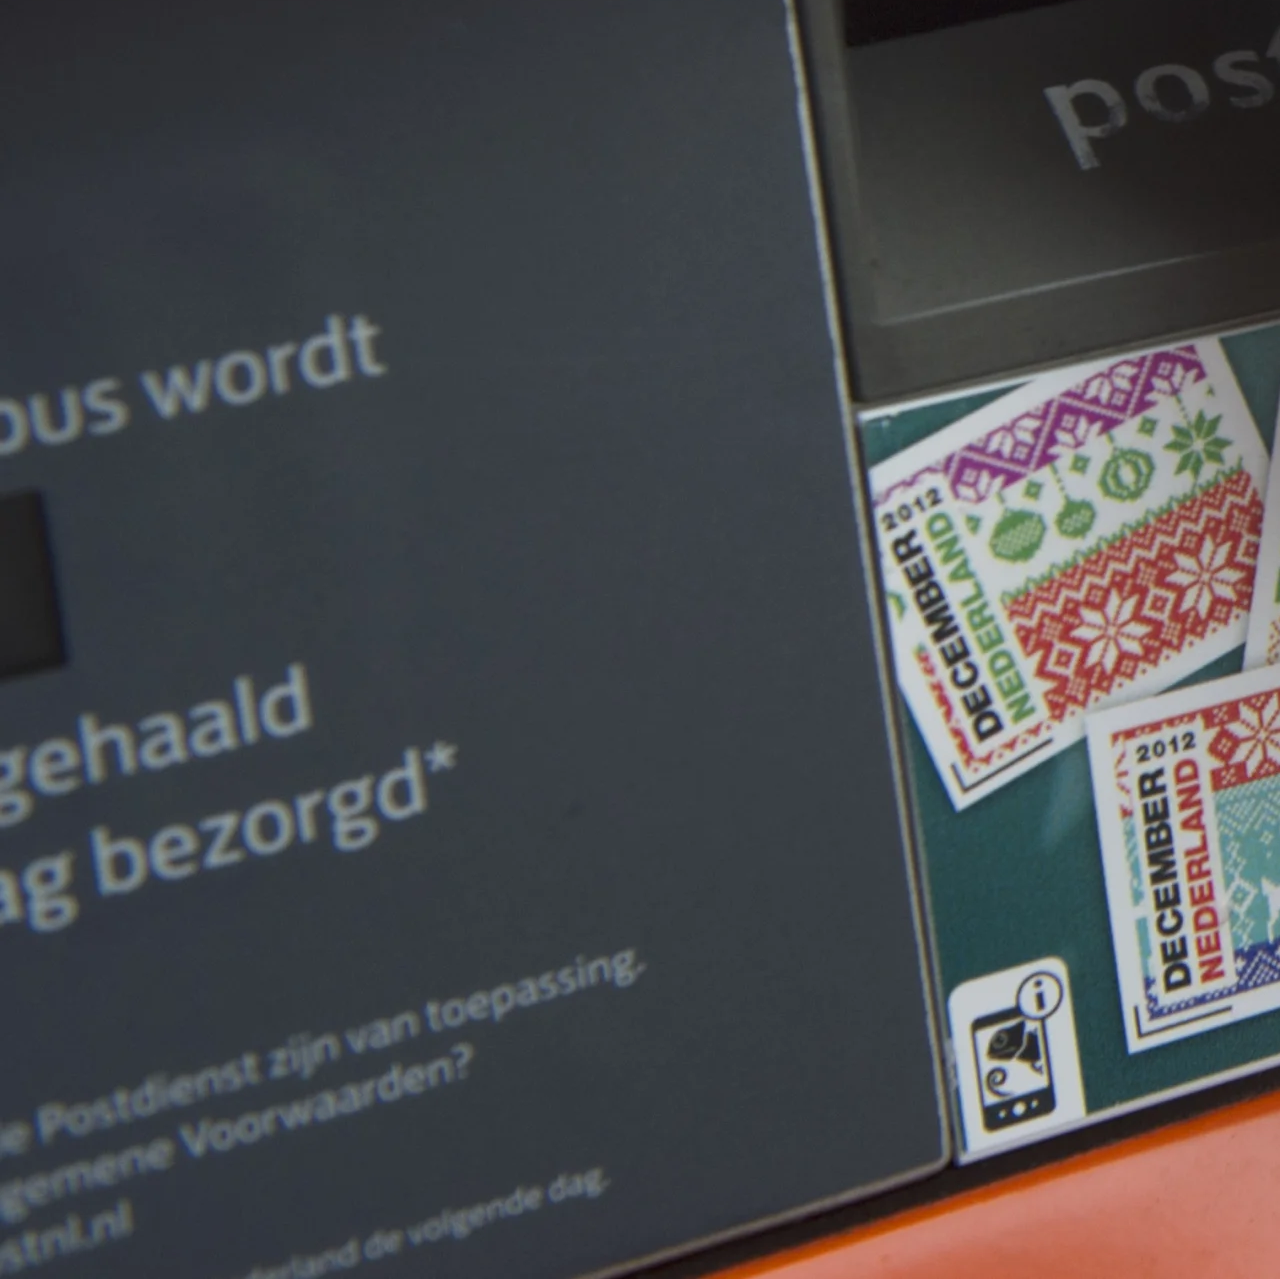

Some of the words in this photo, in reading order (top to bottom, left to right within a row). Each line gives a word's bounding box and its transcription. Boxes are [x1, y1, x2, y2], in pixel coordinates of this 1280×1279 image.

[140, 314, 388, 420] wordt
[880, 485, 944, 533] 2012
[890, 529, 1004, 744] DECEMBER
[924, 511, 1037, 725] NEDERLAND
[1136, 731, 1197, 764] 2012
[1137, 766, 1192, 994] DECEMBER
[1173, 757, 1226, 984] NEDERLAND
[35, 1050, 261, 1147] Postdienst
[268, 1030, 342, 1080] zijn
[346, 1010, 421, 1055] van
[425, 947, 648, 1032] toepassing.
[177, 1040, 474, 1159] Voorwaarden?
[363, 1228, 402, 1262] de
[405, 1185, 543, 1241] volgende
